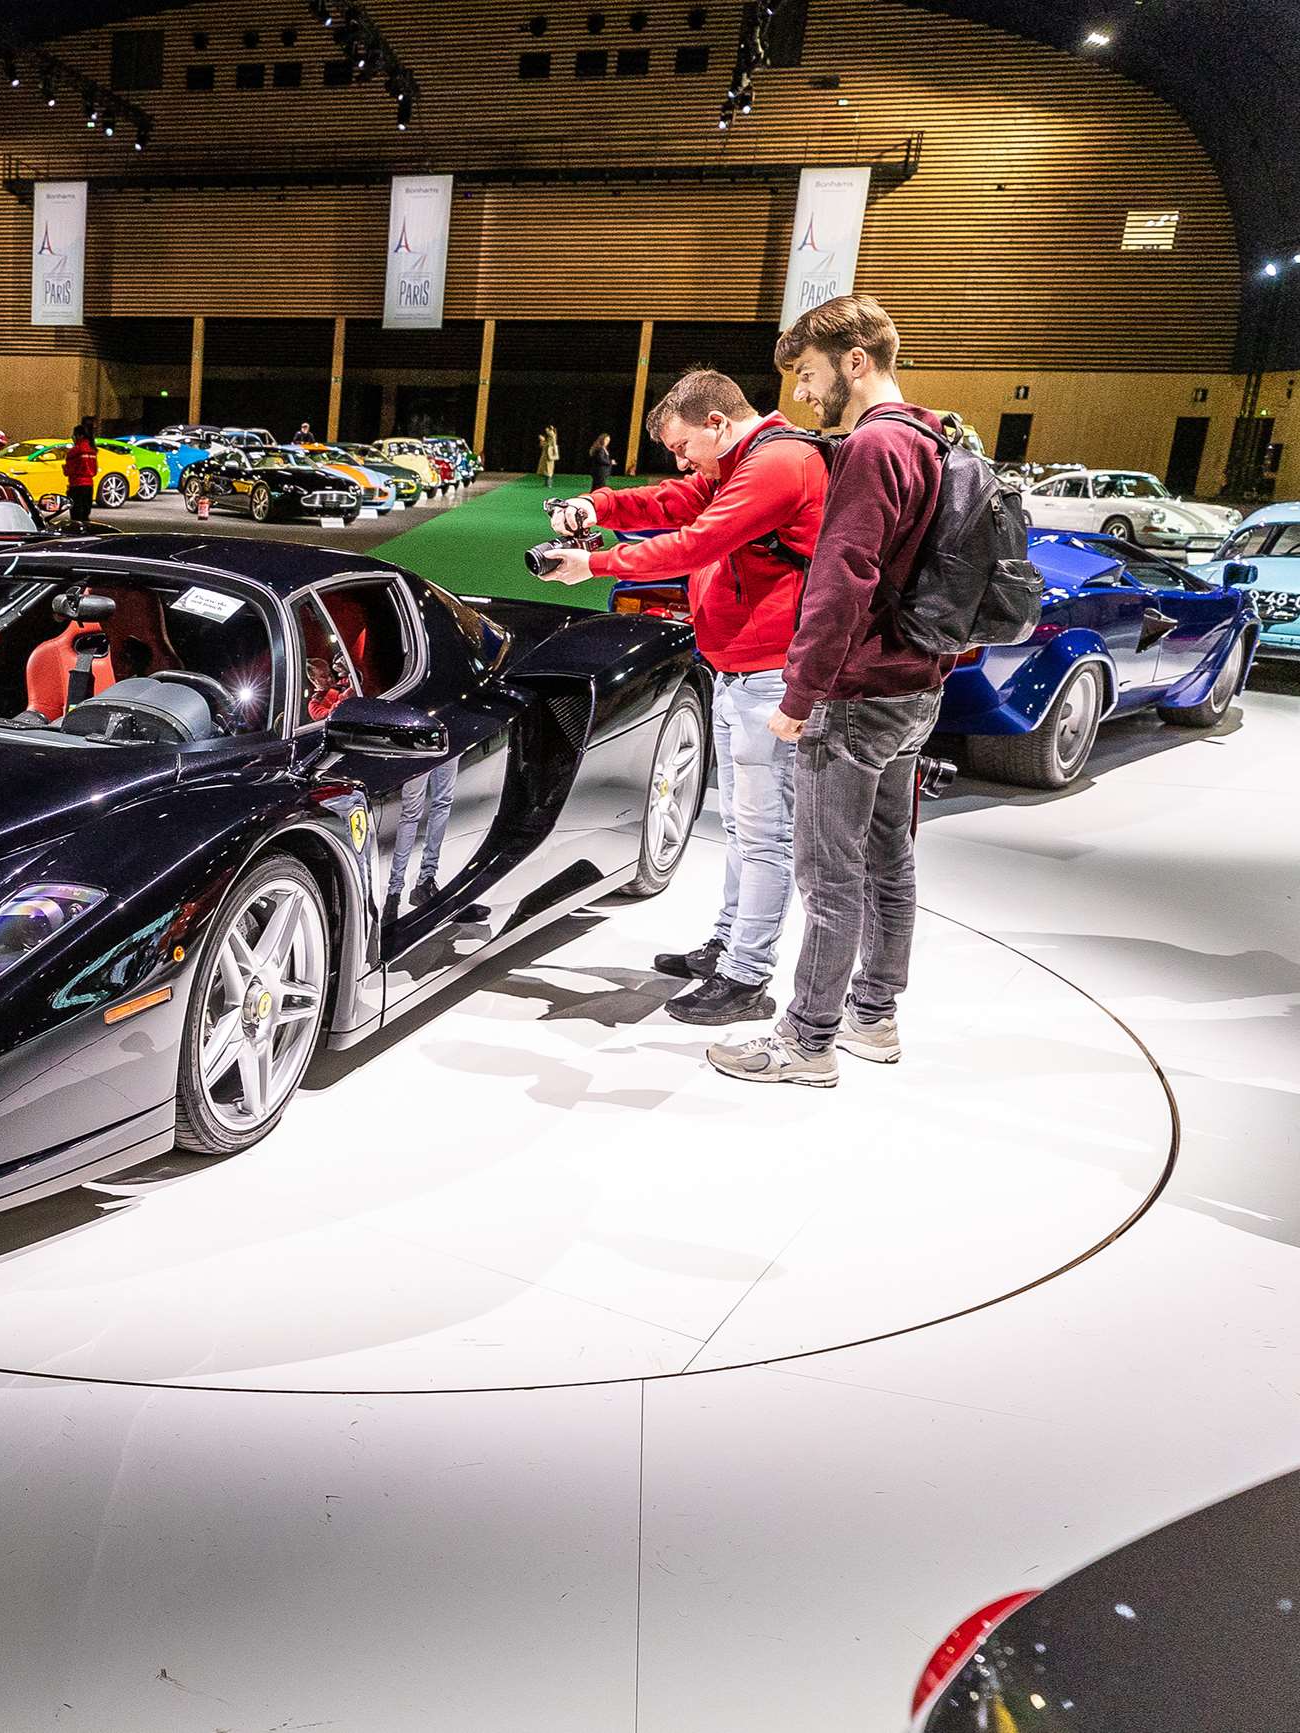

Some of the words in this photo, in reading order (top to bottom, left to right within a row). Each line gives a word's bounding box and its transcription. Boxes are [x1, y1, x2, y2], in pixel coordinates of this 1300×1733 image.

[44, 280, 72, 305] PARIS
[399, 280, 430, 306] PARIS
[800, 280, 837, 307] PARIS
